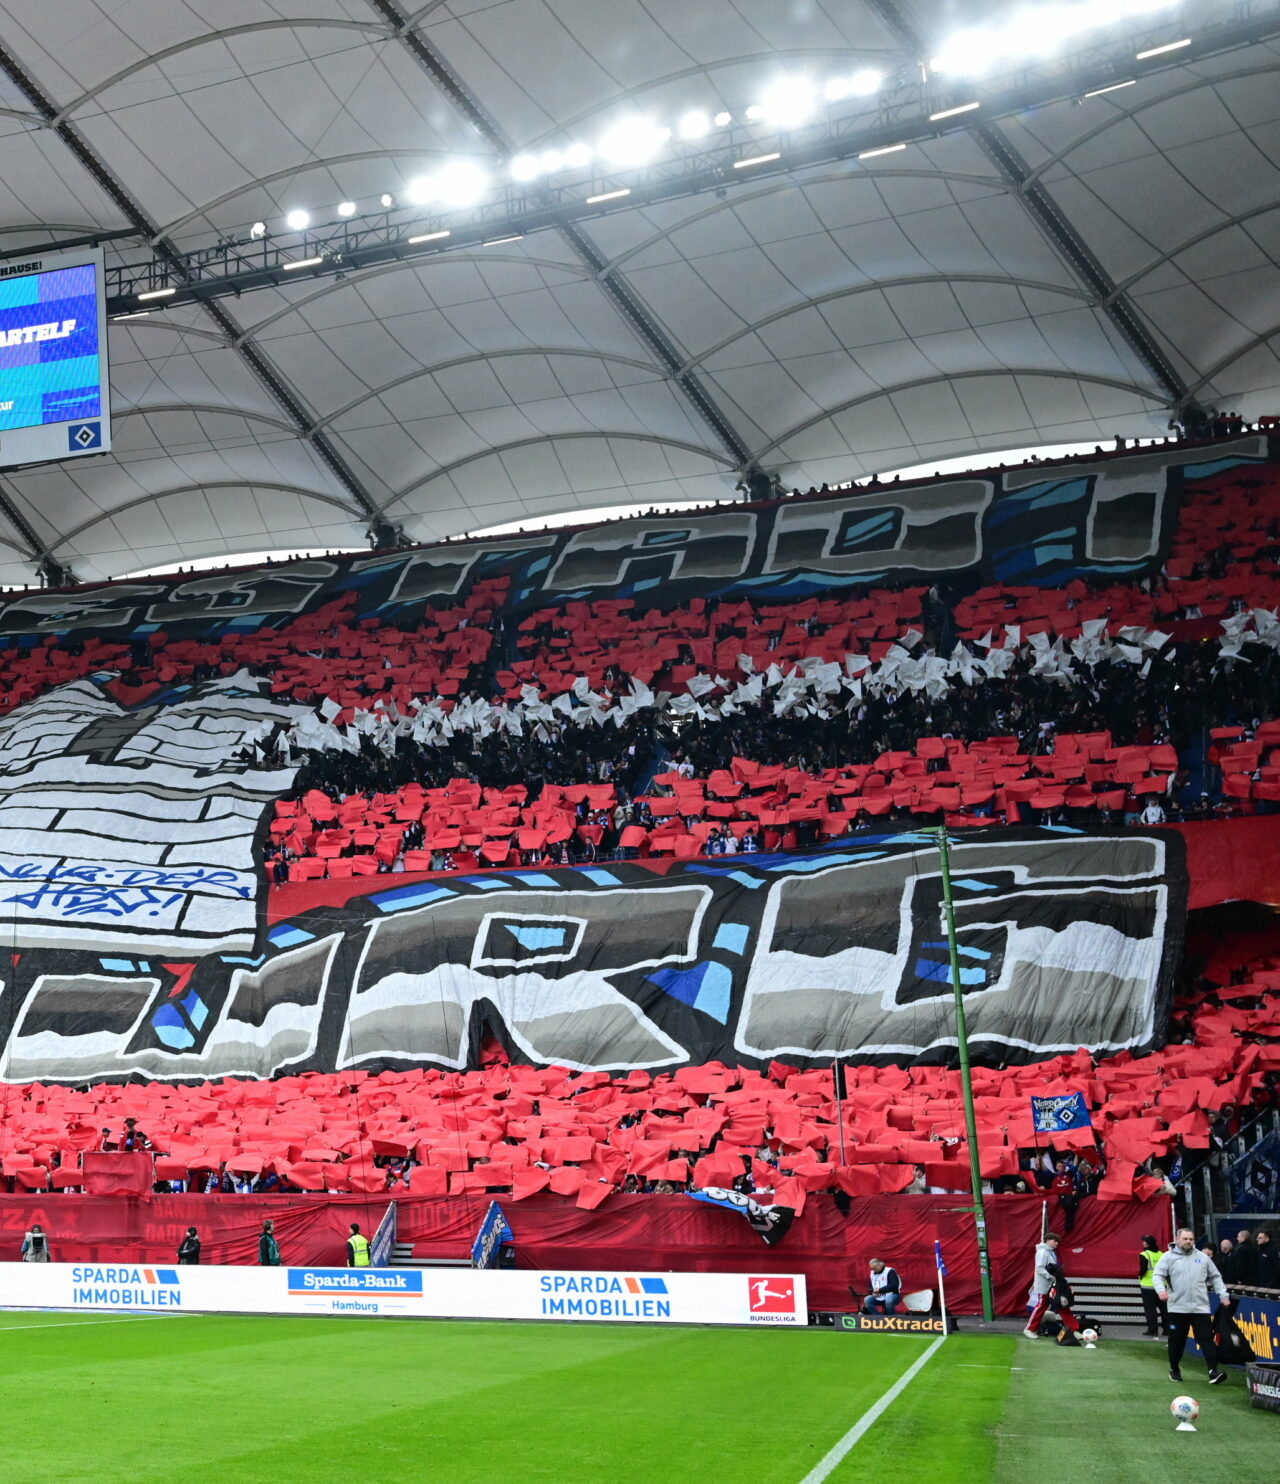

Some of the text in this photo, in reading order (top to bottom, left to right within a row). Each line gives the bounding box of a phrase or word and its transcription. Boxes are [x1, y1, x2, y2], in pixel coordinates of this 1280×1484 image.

[72, 1267, 141, 1284] SPARDA
[303, 1273, 407, 1290] Sparda-Bank
[540, 1276, 621, 1294] SPARDA
[73, 1288, 181, 1305] IMMOBILIEN
[332, 1300, 378, 1313] Hamburg
[541, 1299, 671, 1317] IMMOBILIEN
[860, 1317, 944, 1331] buXtrade
